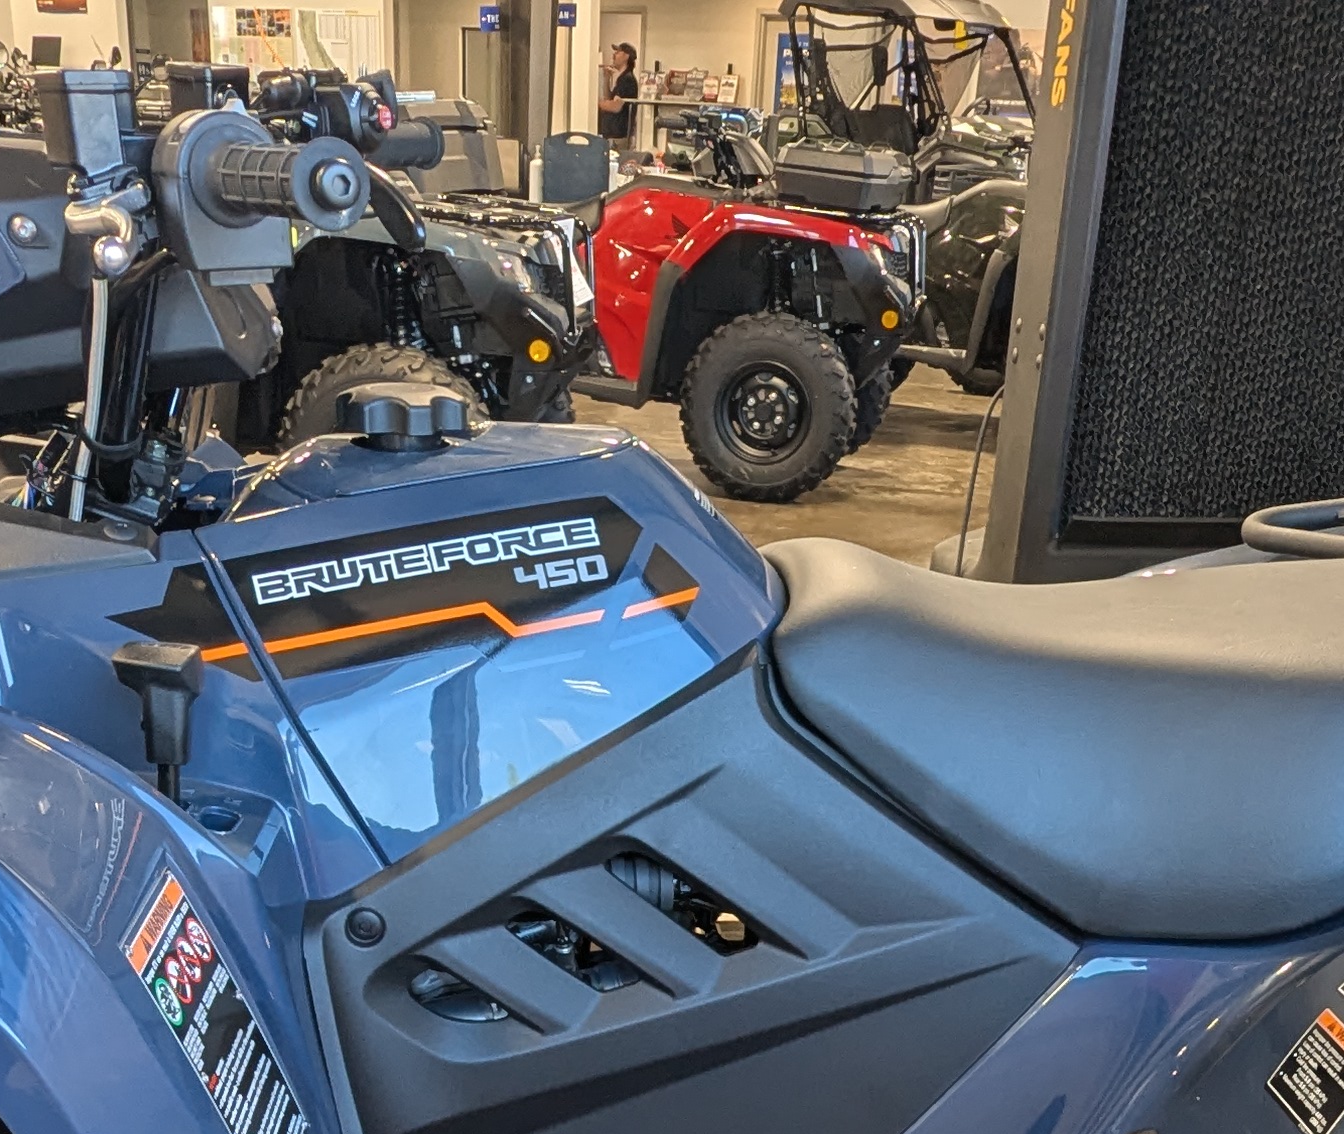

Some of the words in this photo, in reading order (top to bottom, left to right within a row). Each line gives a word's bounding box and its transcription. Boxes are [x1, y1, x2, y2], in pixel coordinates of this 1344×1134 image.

[251, 544, 432, 606] BRUTE
[427, 517, 601, 572] FORCE
[513, 553, 609, 590] 450
[147, 893, 174, 943] WARNING
